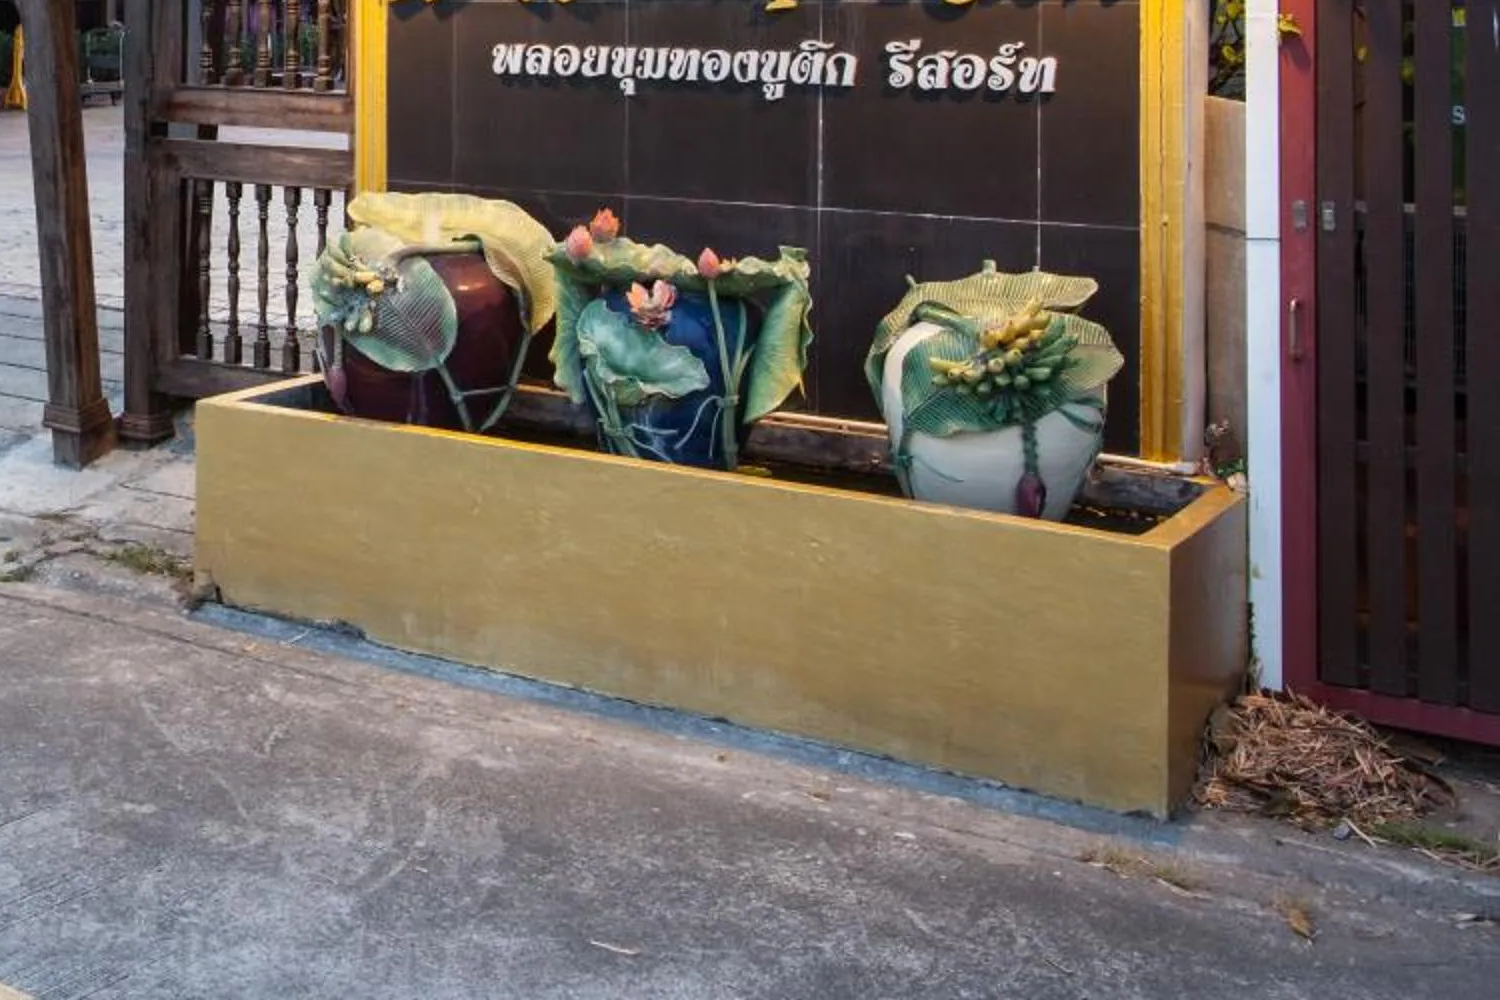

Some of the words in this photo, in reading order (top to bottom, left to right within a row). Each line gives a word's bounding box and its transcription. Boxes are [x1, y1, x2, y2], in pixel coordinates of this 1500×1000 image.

[491, 39, 858, 102] พลอยขุมทองบูติก
[885, 37, 1059, 93] รีสอร์ท
